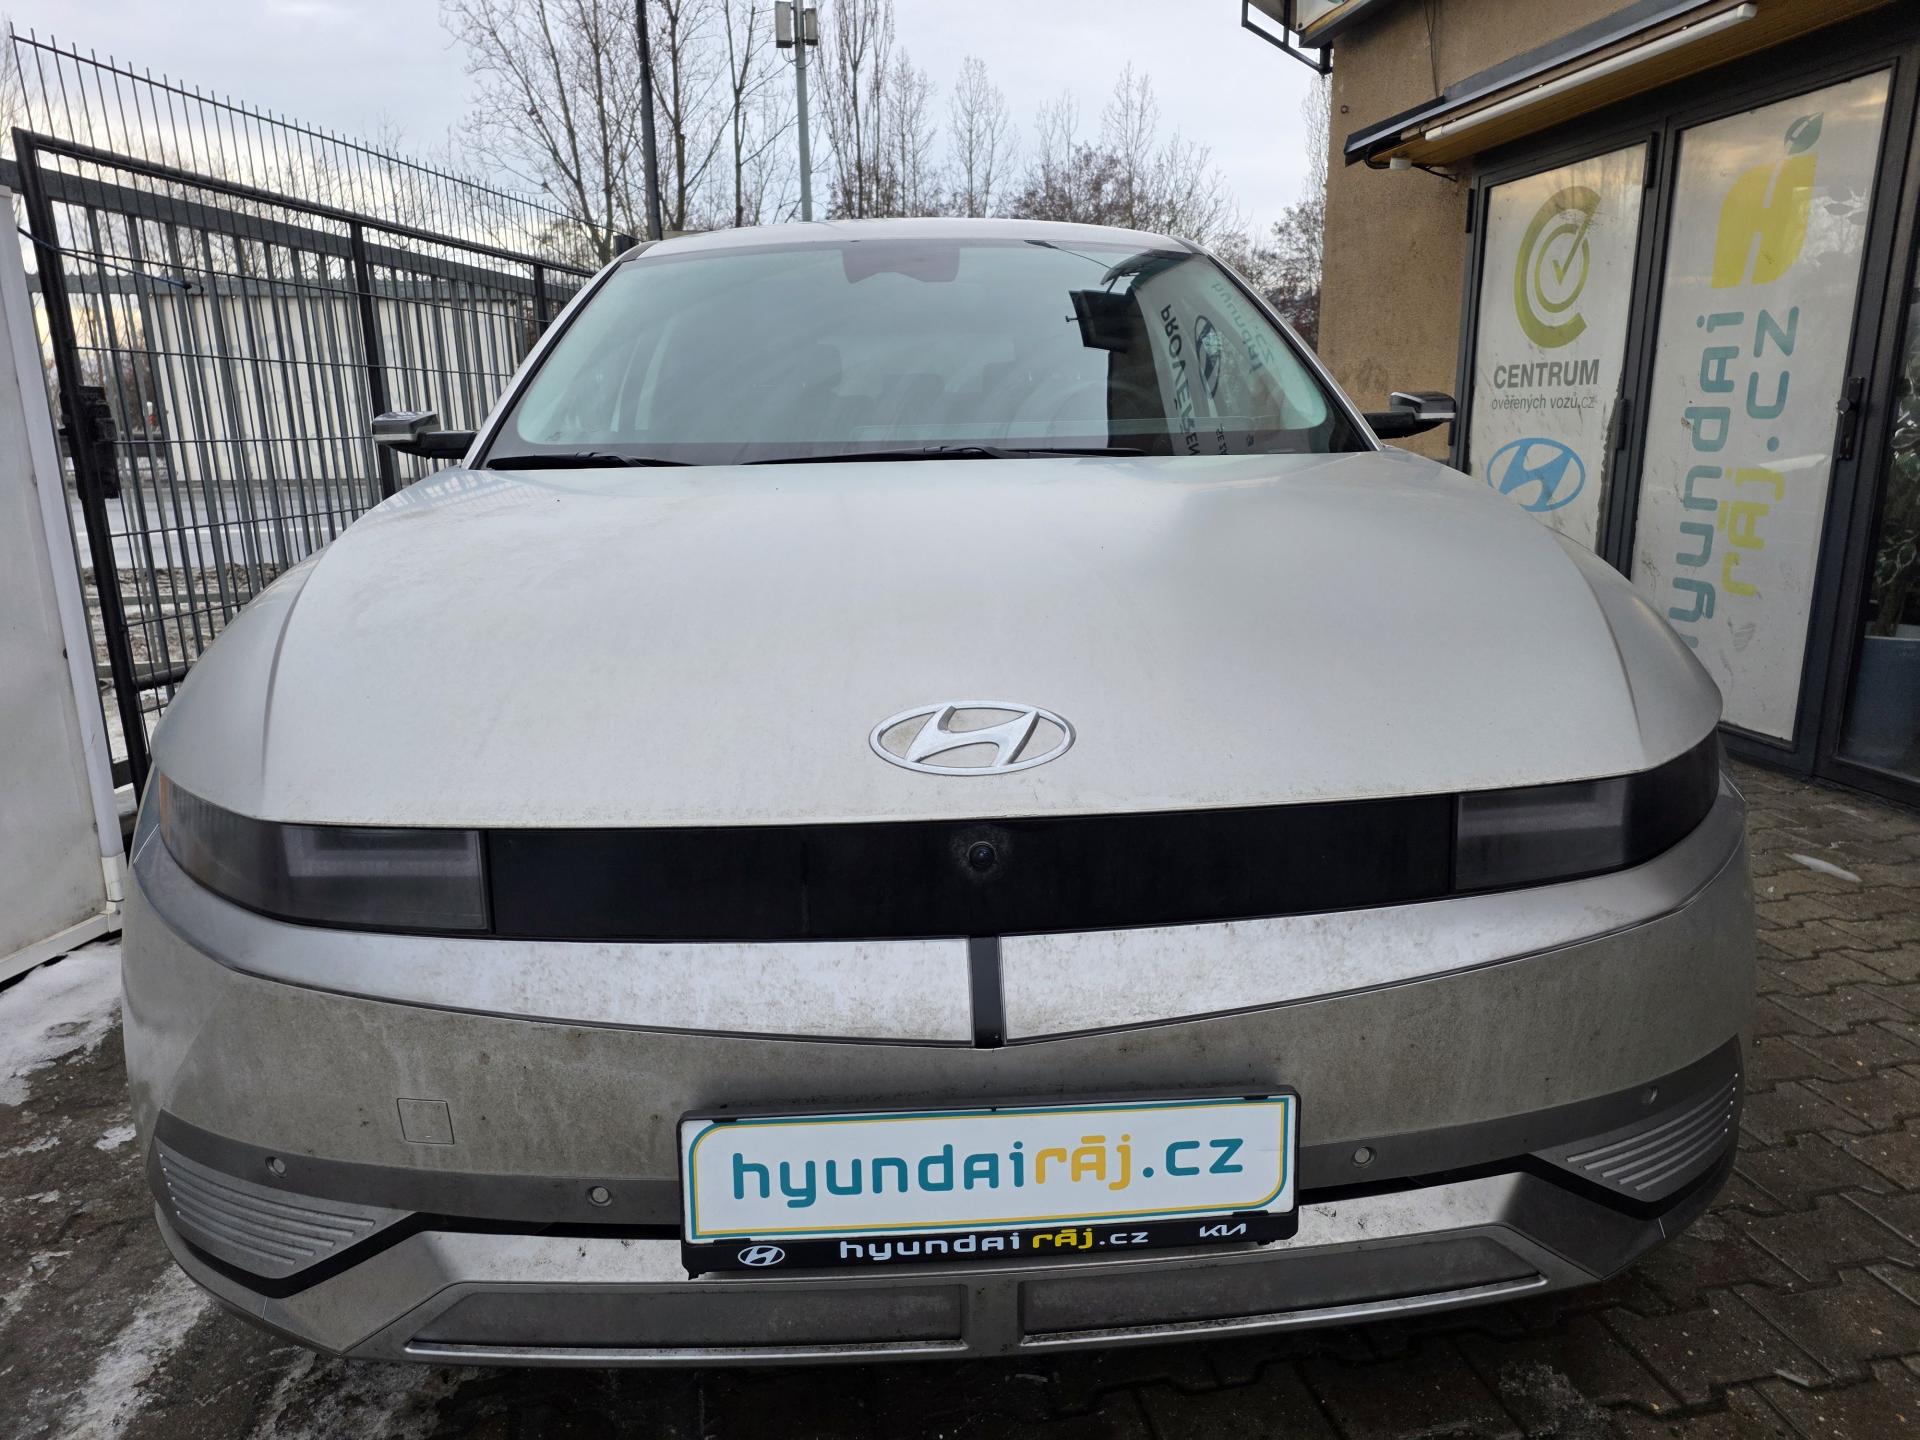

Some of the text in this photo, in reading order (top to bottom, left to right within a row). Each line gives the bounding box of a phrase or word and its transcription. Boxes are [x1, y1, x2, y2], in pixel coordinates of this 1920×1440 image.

[1493, 359, 1600, 389] CENTRUM
[1491, 394, 1547, 413] ověřených
[1668, 312, 1744, 649] yundai
[839, 1232, 1020, 1261] hyundai
